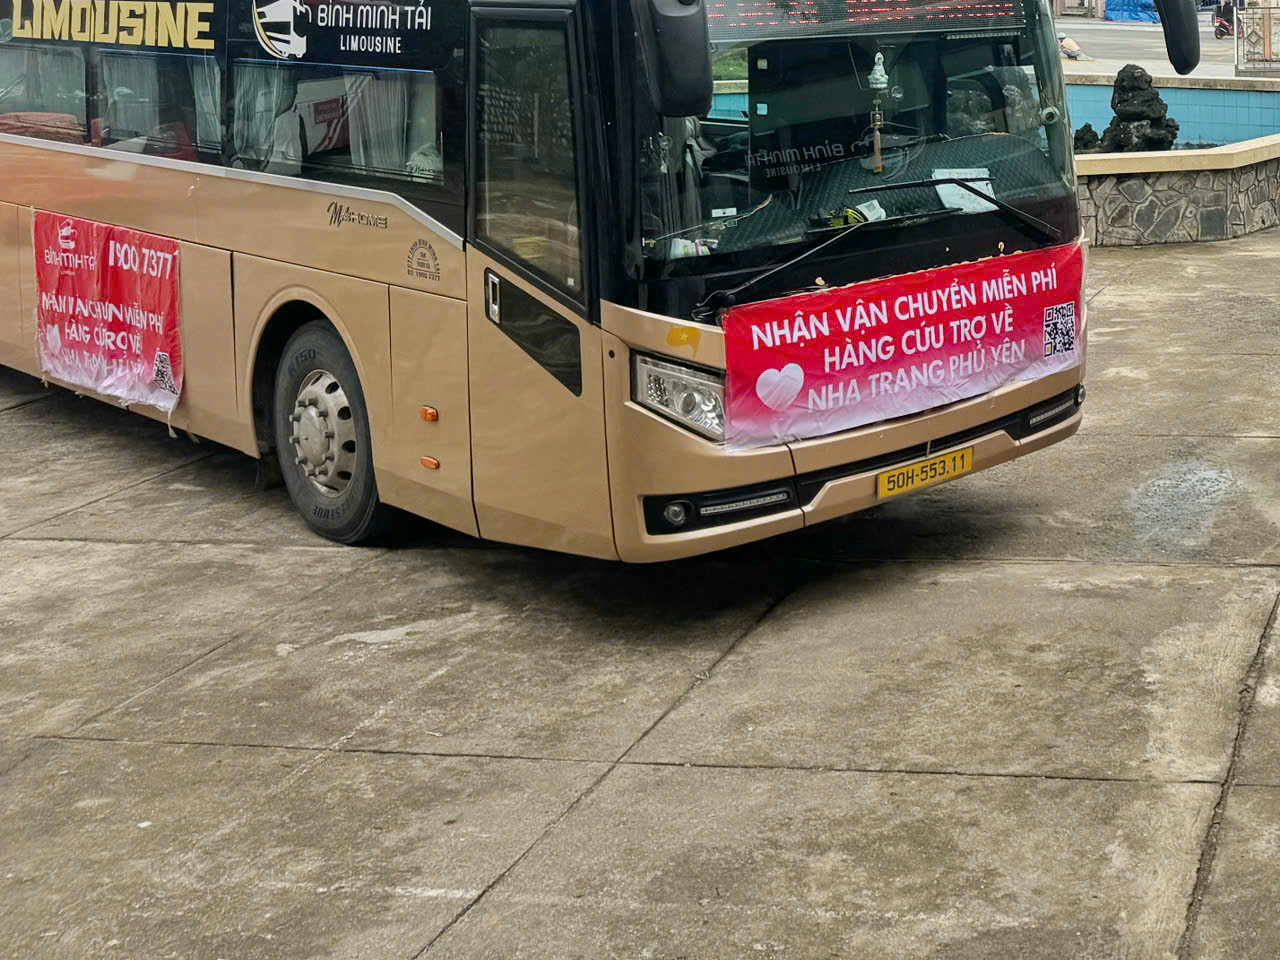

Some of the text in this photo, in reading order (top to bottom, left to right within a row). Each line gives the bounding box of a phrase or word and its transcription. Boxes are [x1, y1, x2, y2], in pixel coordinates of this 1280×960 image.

[357, 5, 399, 30] MINH
[340, 35, 402, 54] LIMOUSINE
[109, 241, 173, 280] 1900 7377
[752, 262, 1057, 348] NHẬN VẬN CHUYỂN MIỄN PHÍ
[824, 302, 1014, 373] HÀNG CỨU TRỢ VỀ
[808, 379, 862, 413] NHA
[868, 360, 945, 398] TRANG
[991, 337, 1025, 368] YÊN
[887, 453, 965, 491] 50H-553.11
